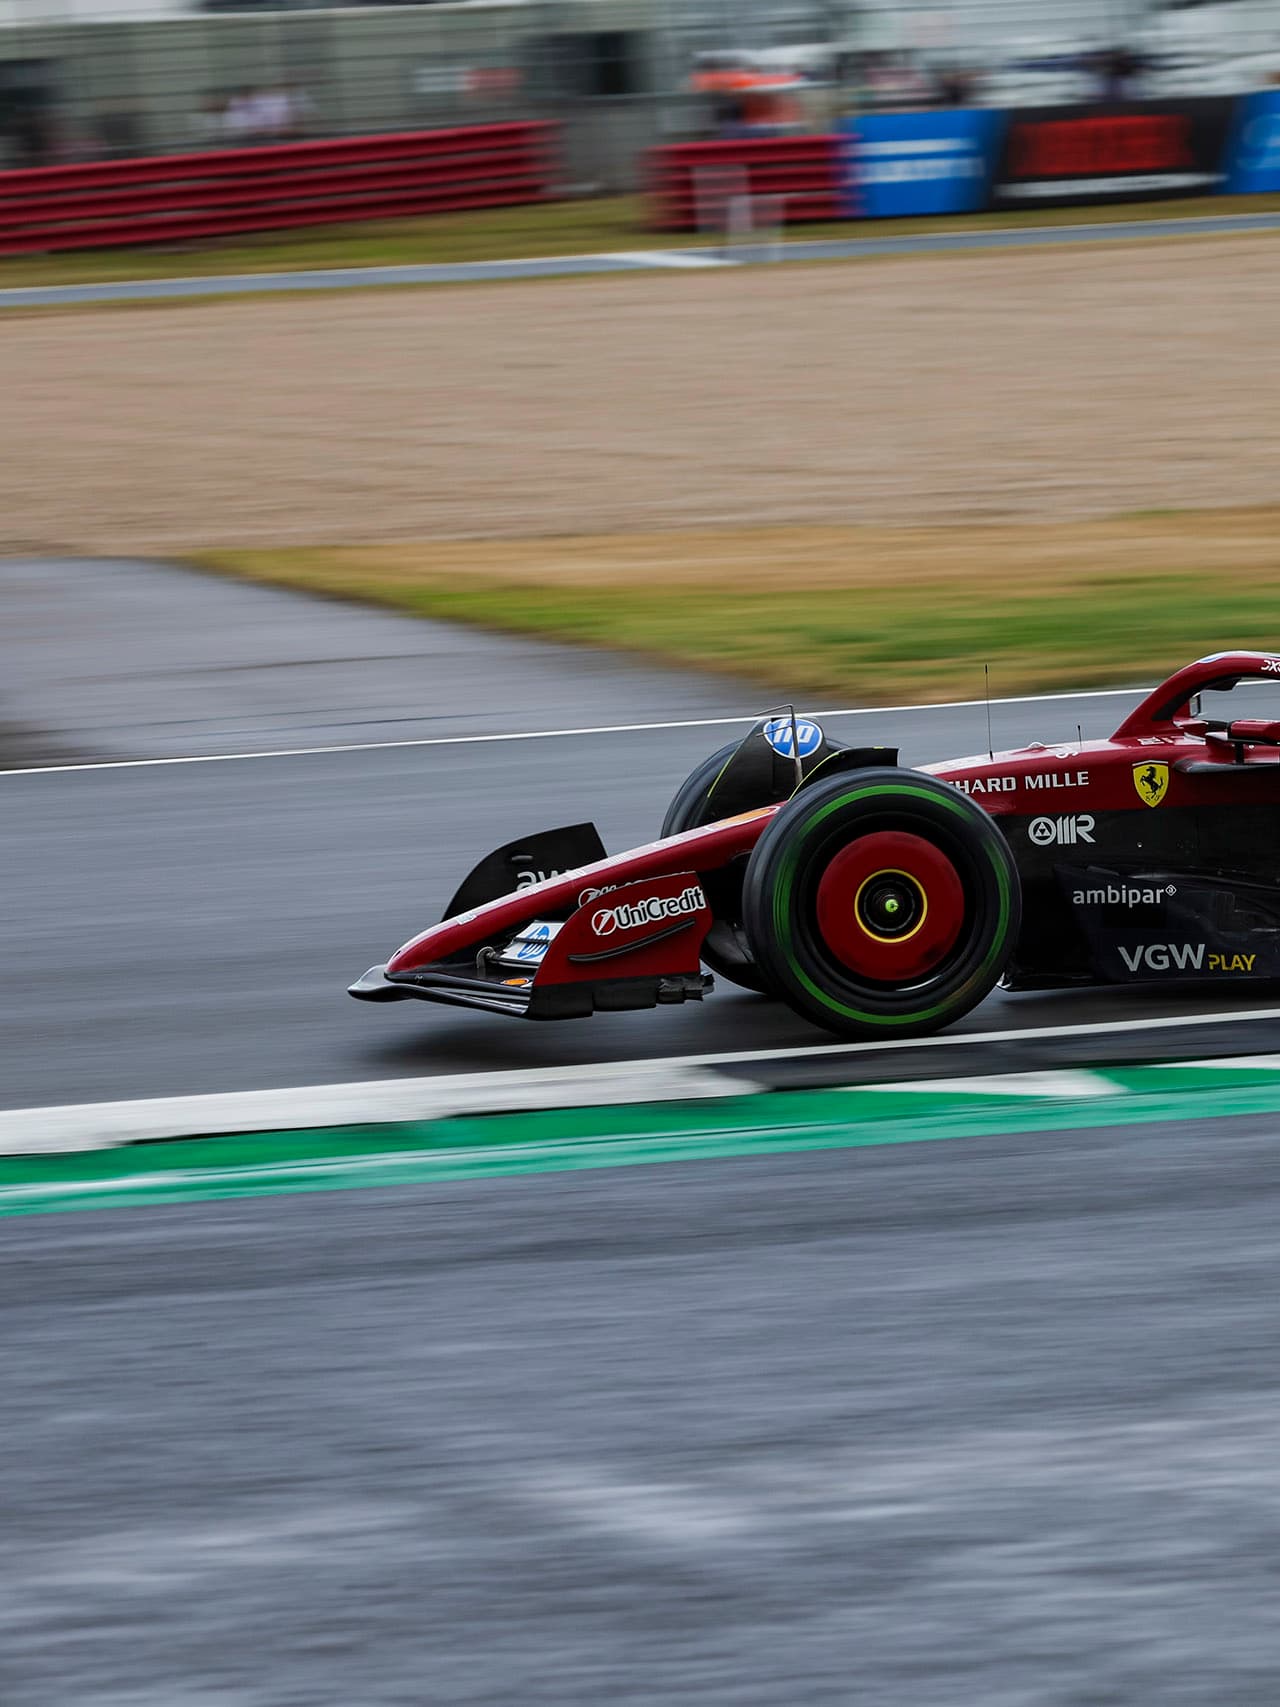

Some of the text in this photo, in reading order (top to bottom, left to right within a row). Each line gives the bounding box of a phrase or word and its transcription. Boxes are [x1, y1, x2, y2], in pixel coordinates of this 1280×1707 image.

[1025, 771, 1090, 790] MILLE
[614, 887, 706, 929] UniCredit
[1073, 884, 1165, 908] ambipar
[1117, 943, 1256, 972] VGW PLAY
